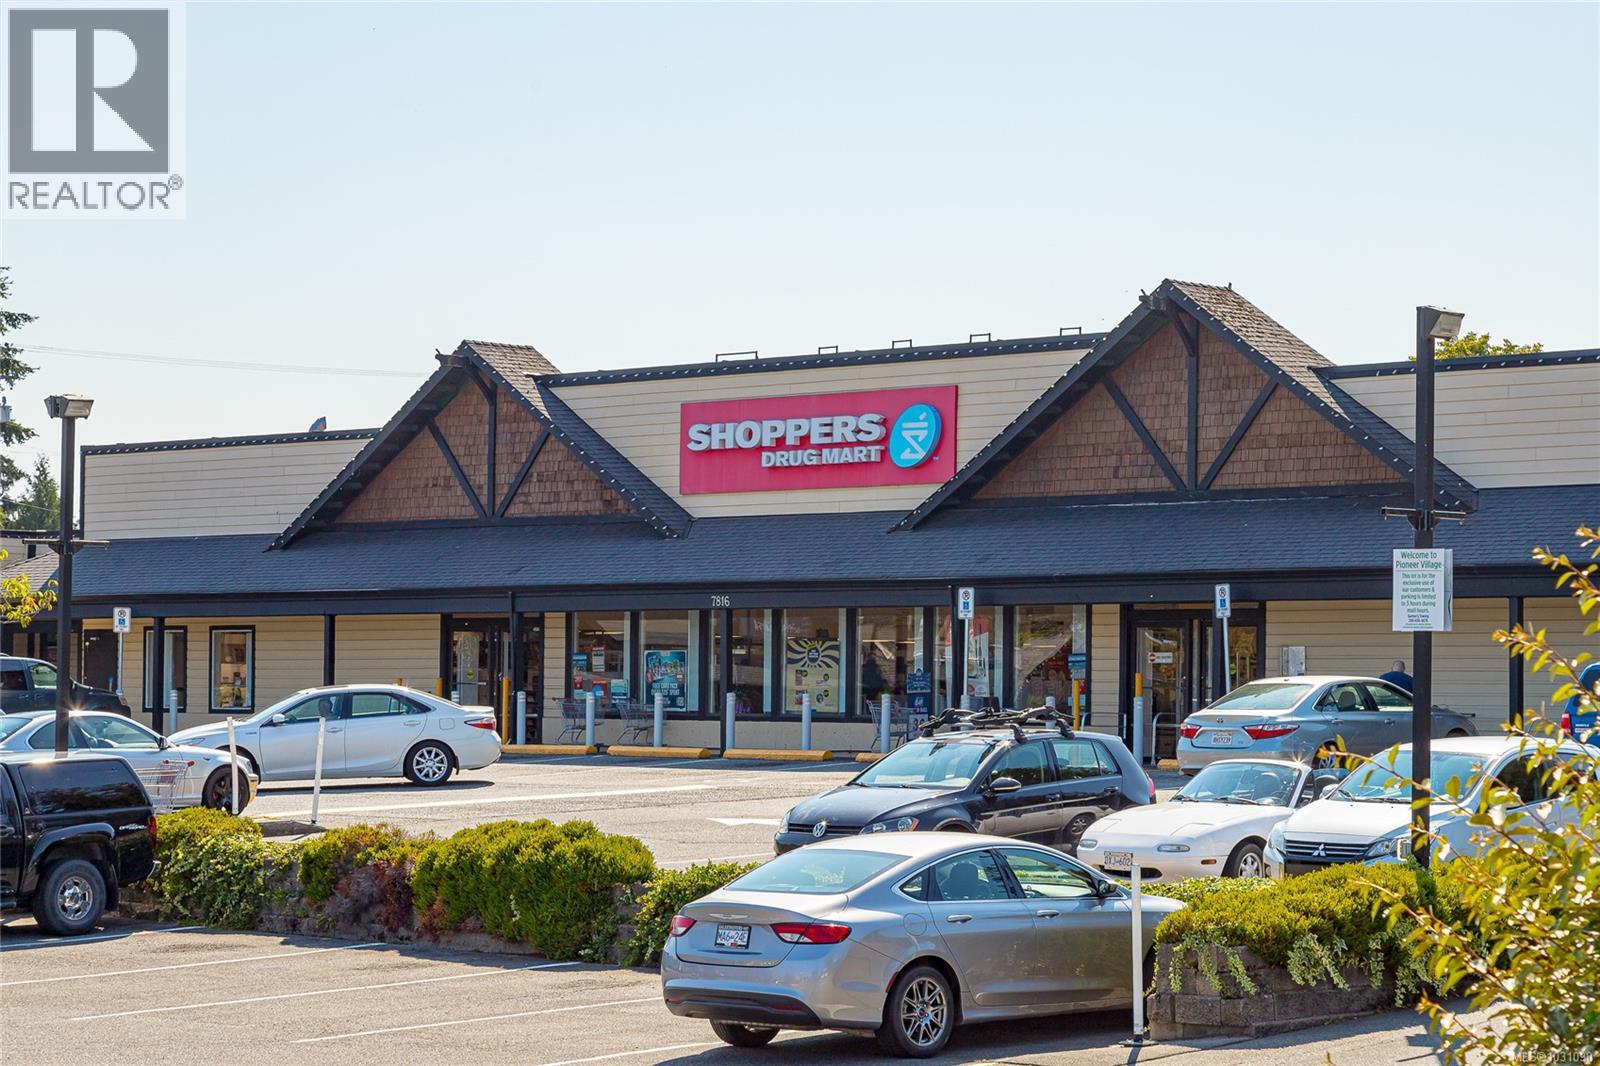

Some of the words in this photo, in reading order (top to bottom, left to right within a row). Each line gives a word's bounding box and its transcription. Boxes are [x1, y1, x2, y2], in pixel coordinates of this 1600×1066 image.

[686, 413, 887, 451] SHOPPERS
[761, 449, 821, 468] DRUG
[822, 445, 883, 464] MART
[1396, 560, 1420, 568] Pioneer
[1420, 561, 1442, 570] Village
[711, 595, 730, 607] 7816
